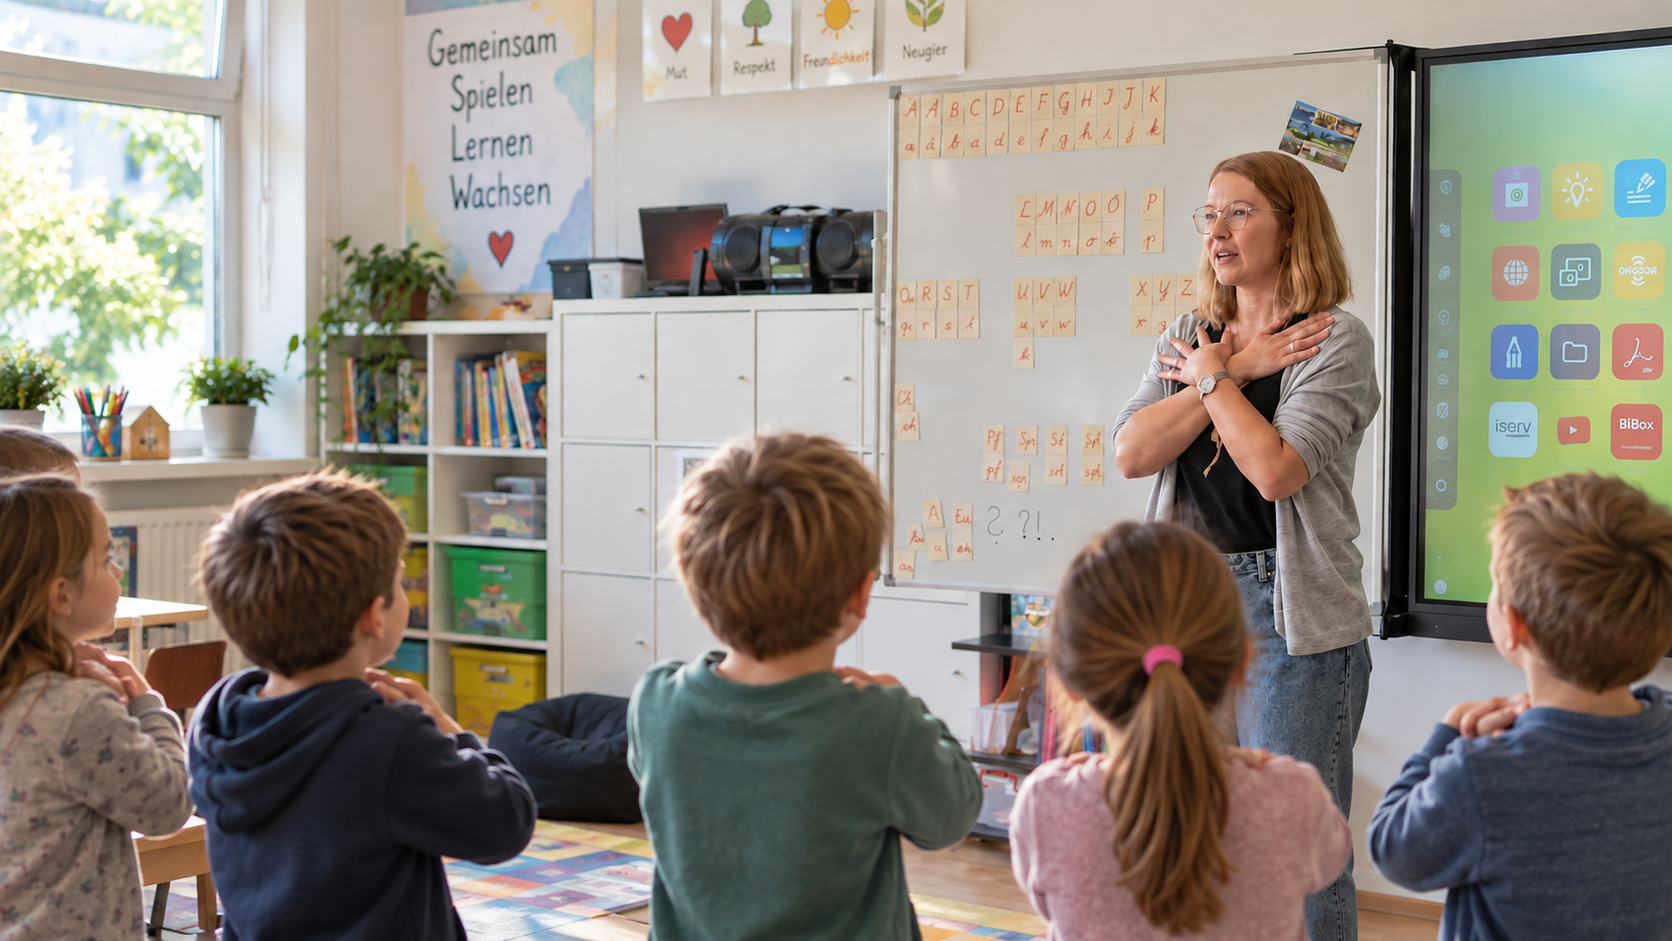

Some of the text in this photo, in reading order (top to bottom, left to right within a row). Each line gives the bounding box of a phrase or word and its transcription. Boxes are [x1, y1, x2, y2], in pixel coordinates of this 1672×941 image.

[427, 28, 557, 68] Gemeinsam
[902, 42, 948, 63] Neugier
[665, 66, 688, 80] Mut
[733, 57, 776, 78] Respekt
[451, 71, 534, 123] Spielen
[949, 101, 960, 118] B
[969, 98, 981, 117] C
[992, 97, 1005, 116] D
[1015, 94, 1026, 113] E
[1037, 93, 1049, 111] F
[1058, 91, 1070, 116] G
[1080, 90, 1093, 108] H
[1123, 86, 1136, 110] J
[1149, 85, 1161, 103] K
[451, 124, 533, 162] Lernen
[994, 131, 1005, 147] d
[1017, 135, 1025, 146] e
[1059, 134, 1069, 150] g
[1077, 121, 1093, 140] h
[1102, 123, 1112, 140] i
[1125, 121, 1135, 144] j
[449, 171, 551, 210] Wachsen
[1037, 201, 1054, 218] M
[1146, 193, 1157, 211] P
[1040, 239, 1054, 248] m
[1061, 239, 1071, 248] n
[922, 285, 931, 302] R
[942, 285, 952, 301] S
[964, 284, 975, 301] T
[1017, 281, 1074, 300] U V W
[1136, 281, 1147, 297] X
[1180, 279, 1193, 296] Z
[922, 321, 930, 331] r
[944, 321, 952, 331] s
[1039, 320, 1049, 330] v
[1058, 320, 1071, 330] w
[1495, 419, 1532, 434] iserv
[1619, 417, 1654, 430] BiBox
[927, 505, 940, 521] A
